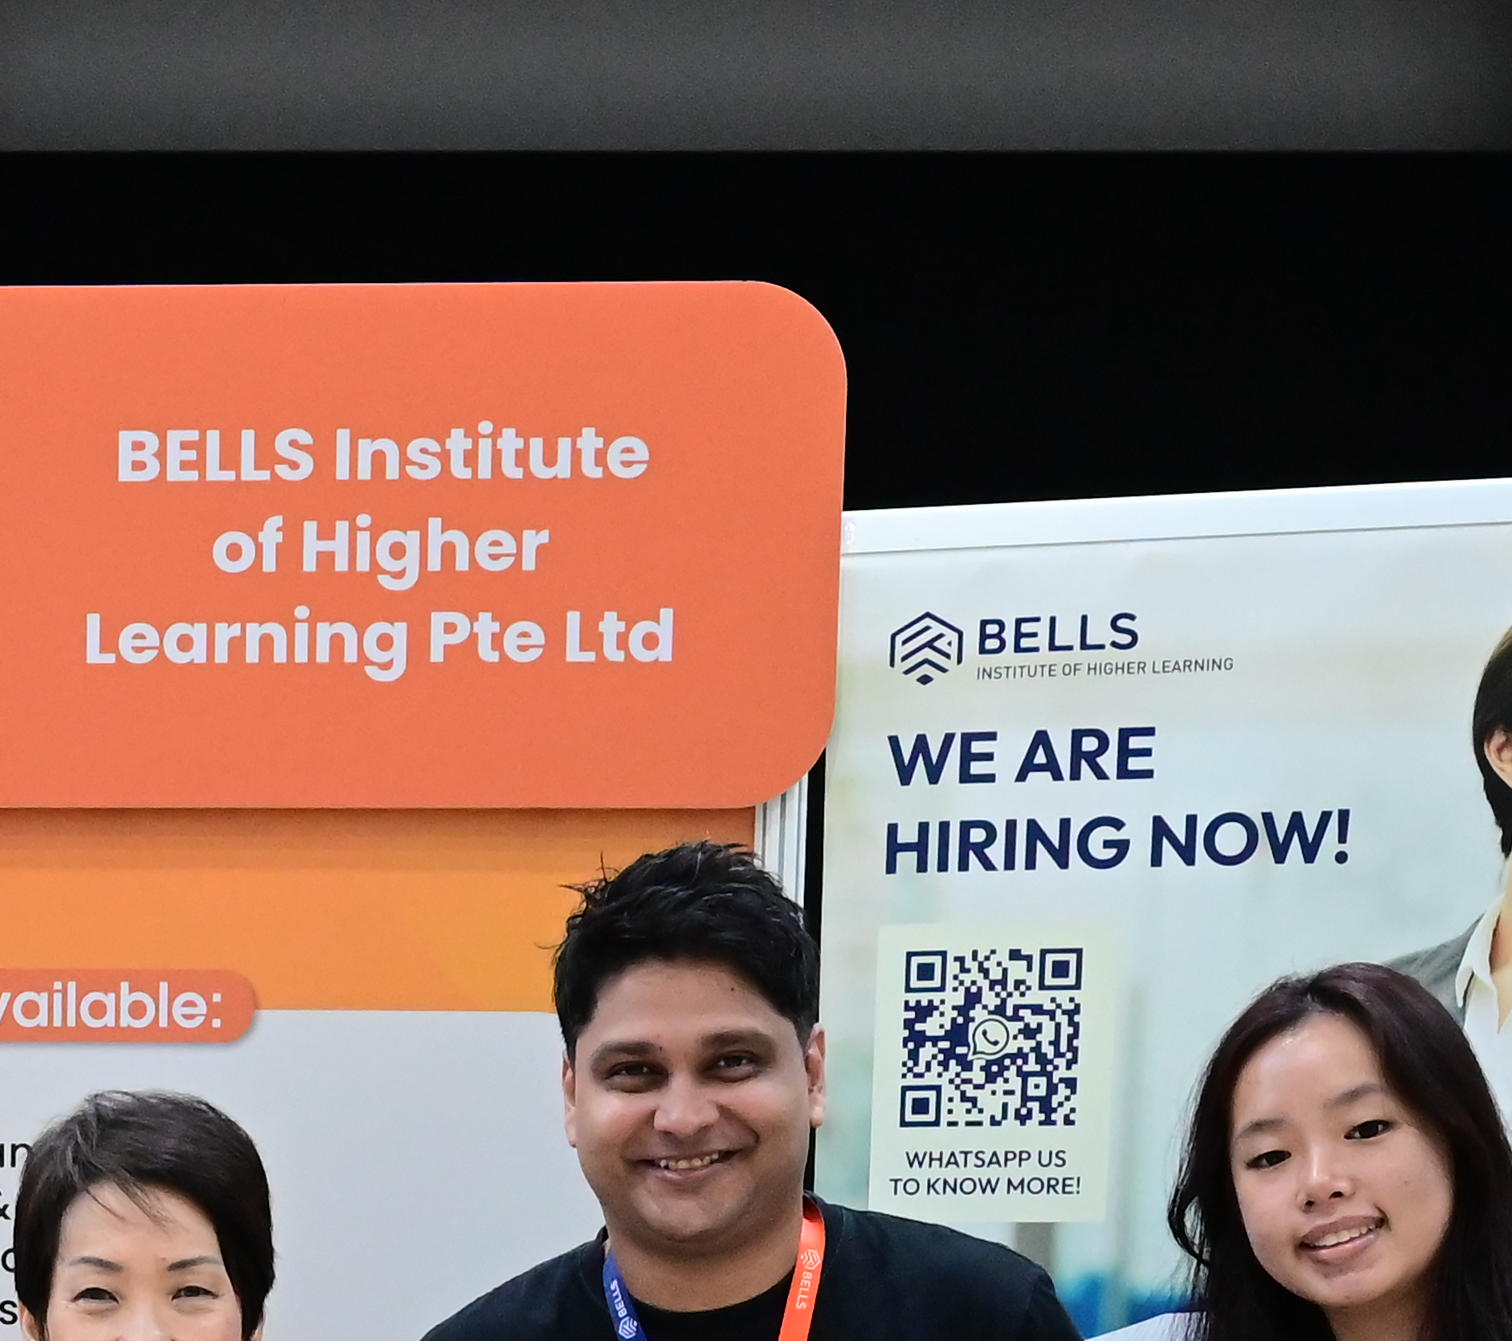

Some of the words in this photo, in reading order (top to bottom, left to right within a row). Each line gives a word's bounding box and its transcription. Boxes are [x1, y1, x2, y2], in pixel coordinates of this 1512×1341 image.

[117, 426, 314, 484] BELLS
[334, 421, 651, 482] Institute
[212, 515, 290, 574] of
[303, 513, 550, 594] Higher
[85, 606, 409, 683] Learning
[428, 610, 547, 666] Pte
[564, 606, 674, 664] Ltd
[978, 612, 1139, 655] BELLS
[976, 664, 1058, 681] INSTITUTE
[1062, 663, 1083, 678] OF
[1087, 660, 1148, 676] HIGHER
[1152, 657, 1234, 674] LEARNING
[887, 731, 998, 787] WE
[1014, 726, 1157, 783] ARE
[885, 816, 1131, 876] HIRING
[1150, 808, 1351, 868] NOW!
[905, 1151, 1031, 1169] WHATSAPP
[1037, 1150, 1067, 1168] US
[889, 1178, 920, 1196] TO
[926, 1177, 1000, 1195] KNOW
[1006, 1176, 1081, 1195] MORE!
[610, 1278, 627, 1319] BELLS
[796, 1270, 811, 1311] BELLS
